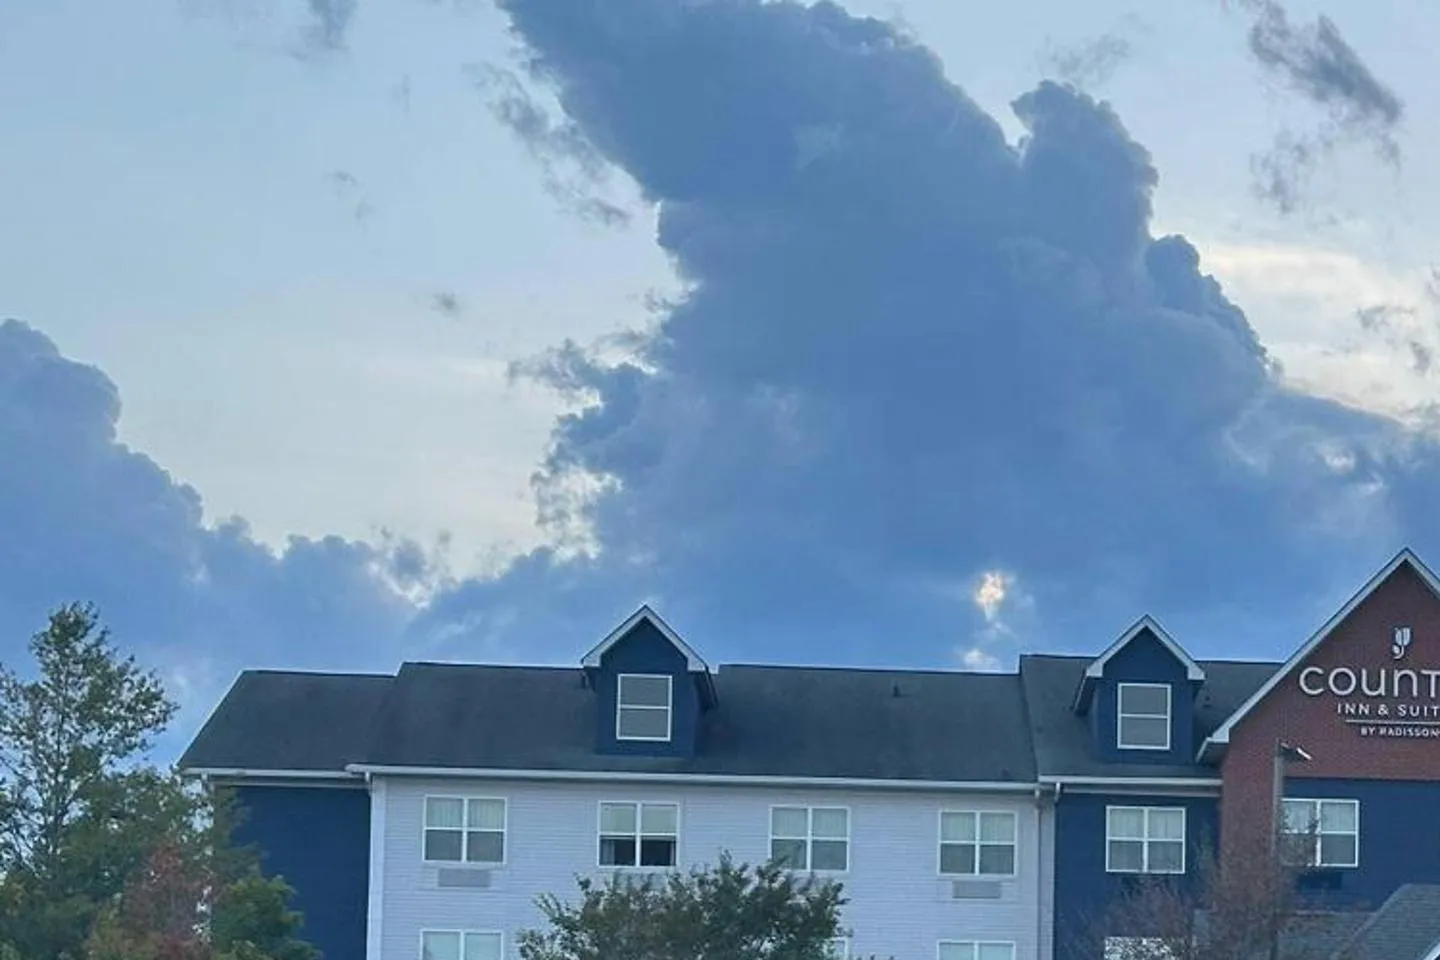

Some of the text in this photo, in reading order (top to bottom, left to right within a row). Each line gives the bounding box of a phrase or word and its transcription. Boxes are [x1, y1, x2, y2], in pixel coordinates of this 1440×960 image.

[1337, 702, 1370, 715] INN
[1377, 704, 1389, 716] &
[1360, 726, 1440, 738] BY RADISSON
